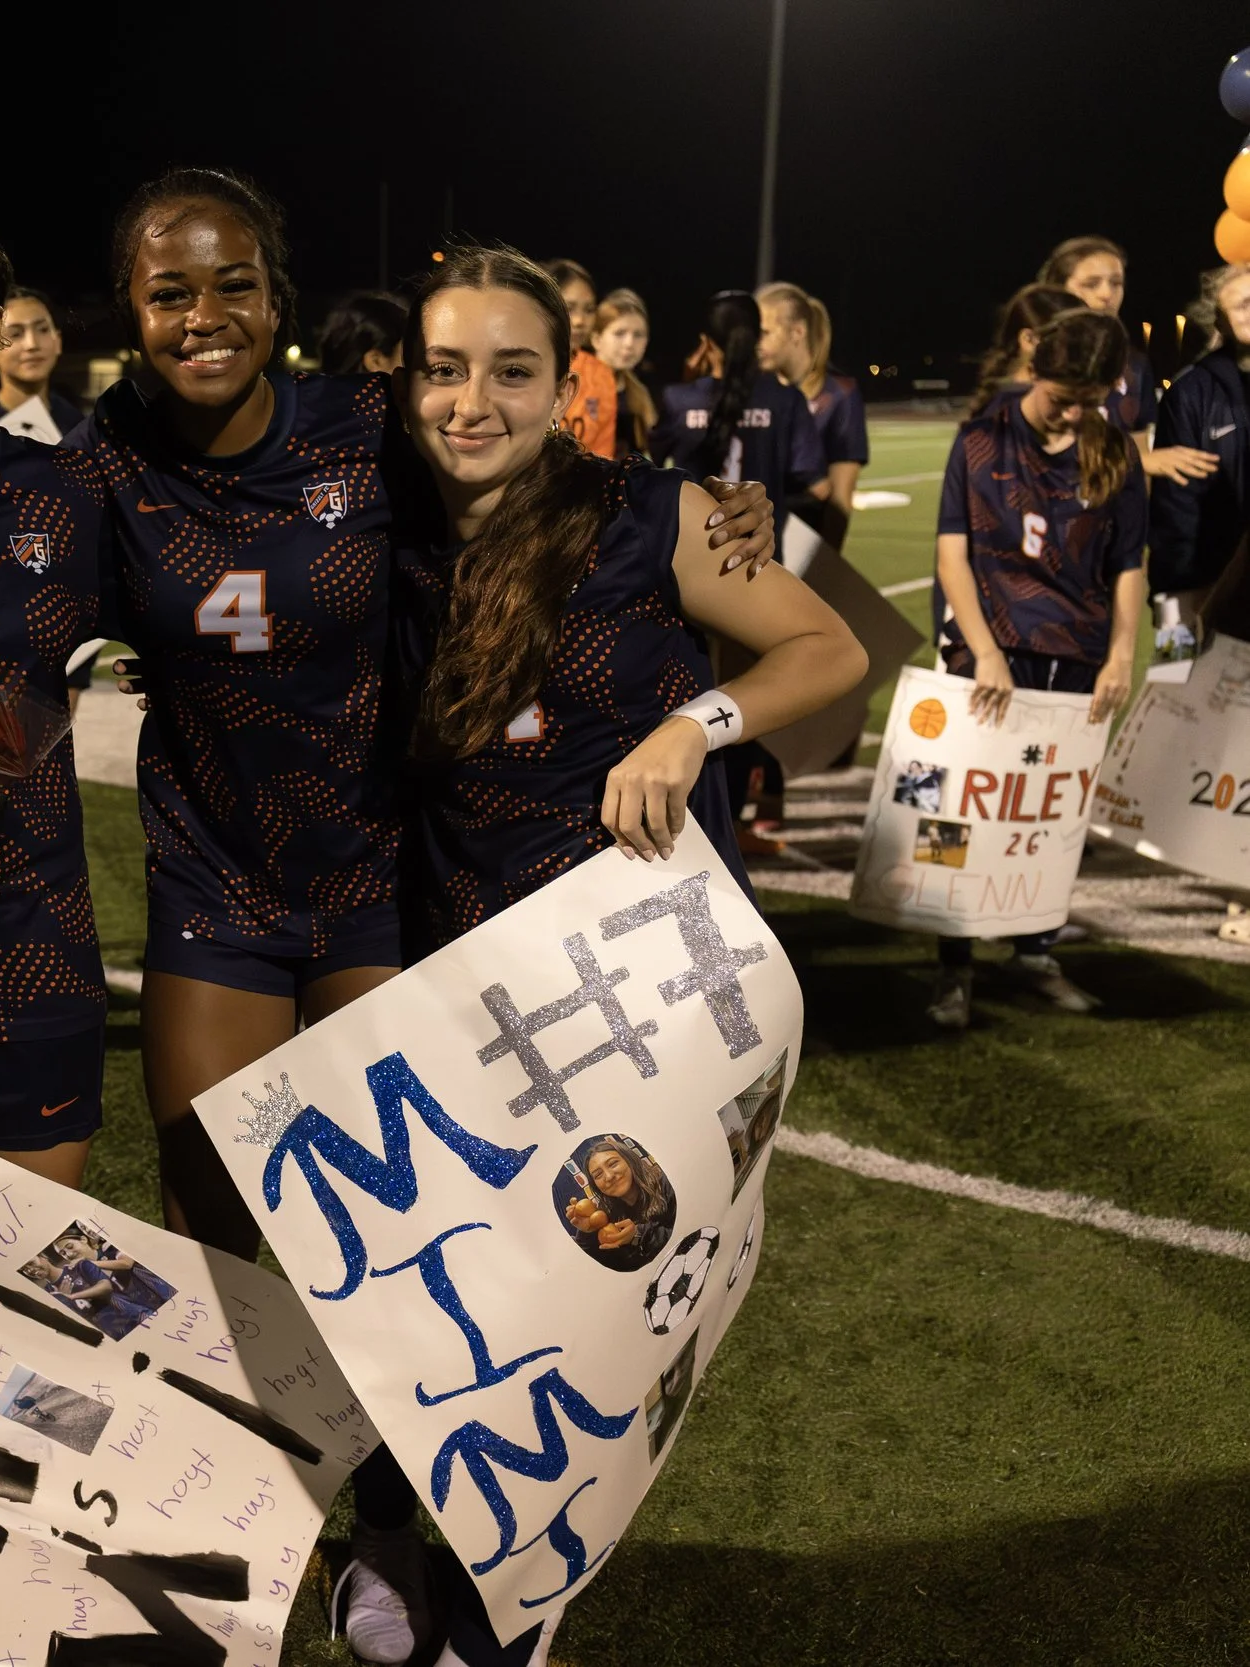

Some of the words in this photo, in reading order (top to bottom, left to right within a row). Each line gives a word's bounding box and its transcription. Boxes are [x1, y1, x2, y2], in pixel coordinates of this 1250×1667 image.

[328, 491, 344, 512] G
[33, 542, 48, 562] G
[194, 569, 275, 654] 4
[958, 762, 1100, 824] RILEY
[879, 863, 1043, 914] GLENN
[474, 870, 769, 1134] #7
[146, 1447, 216, 1520] hoyt
